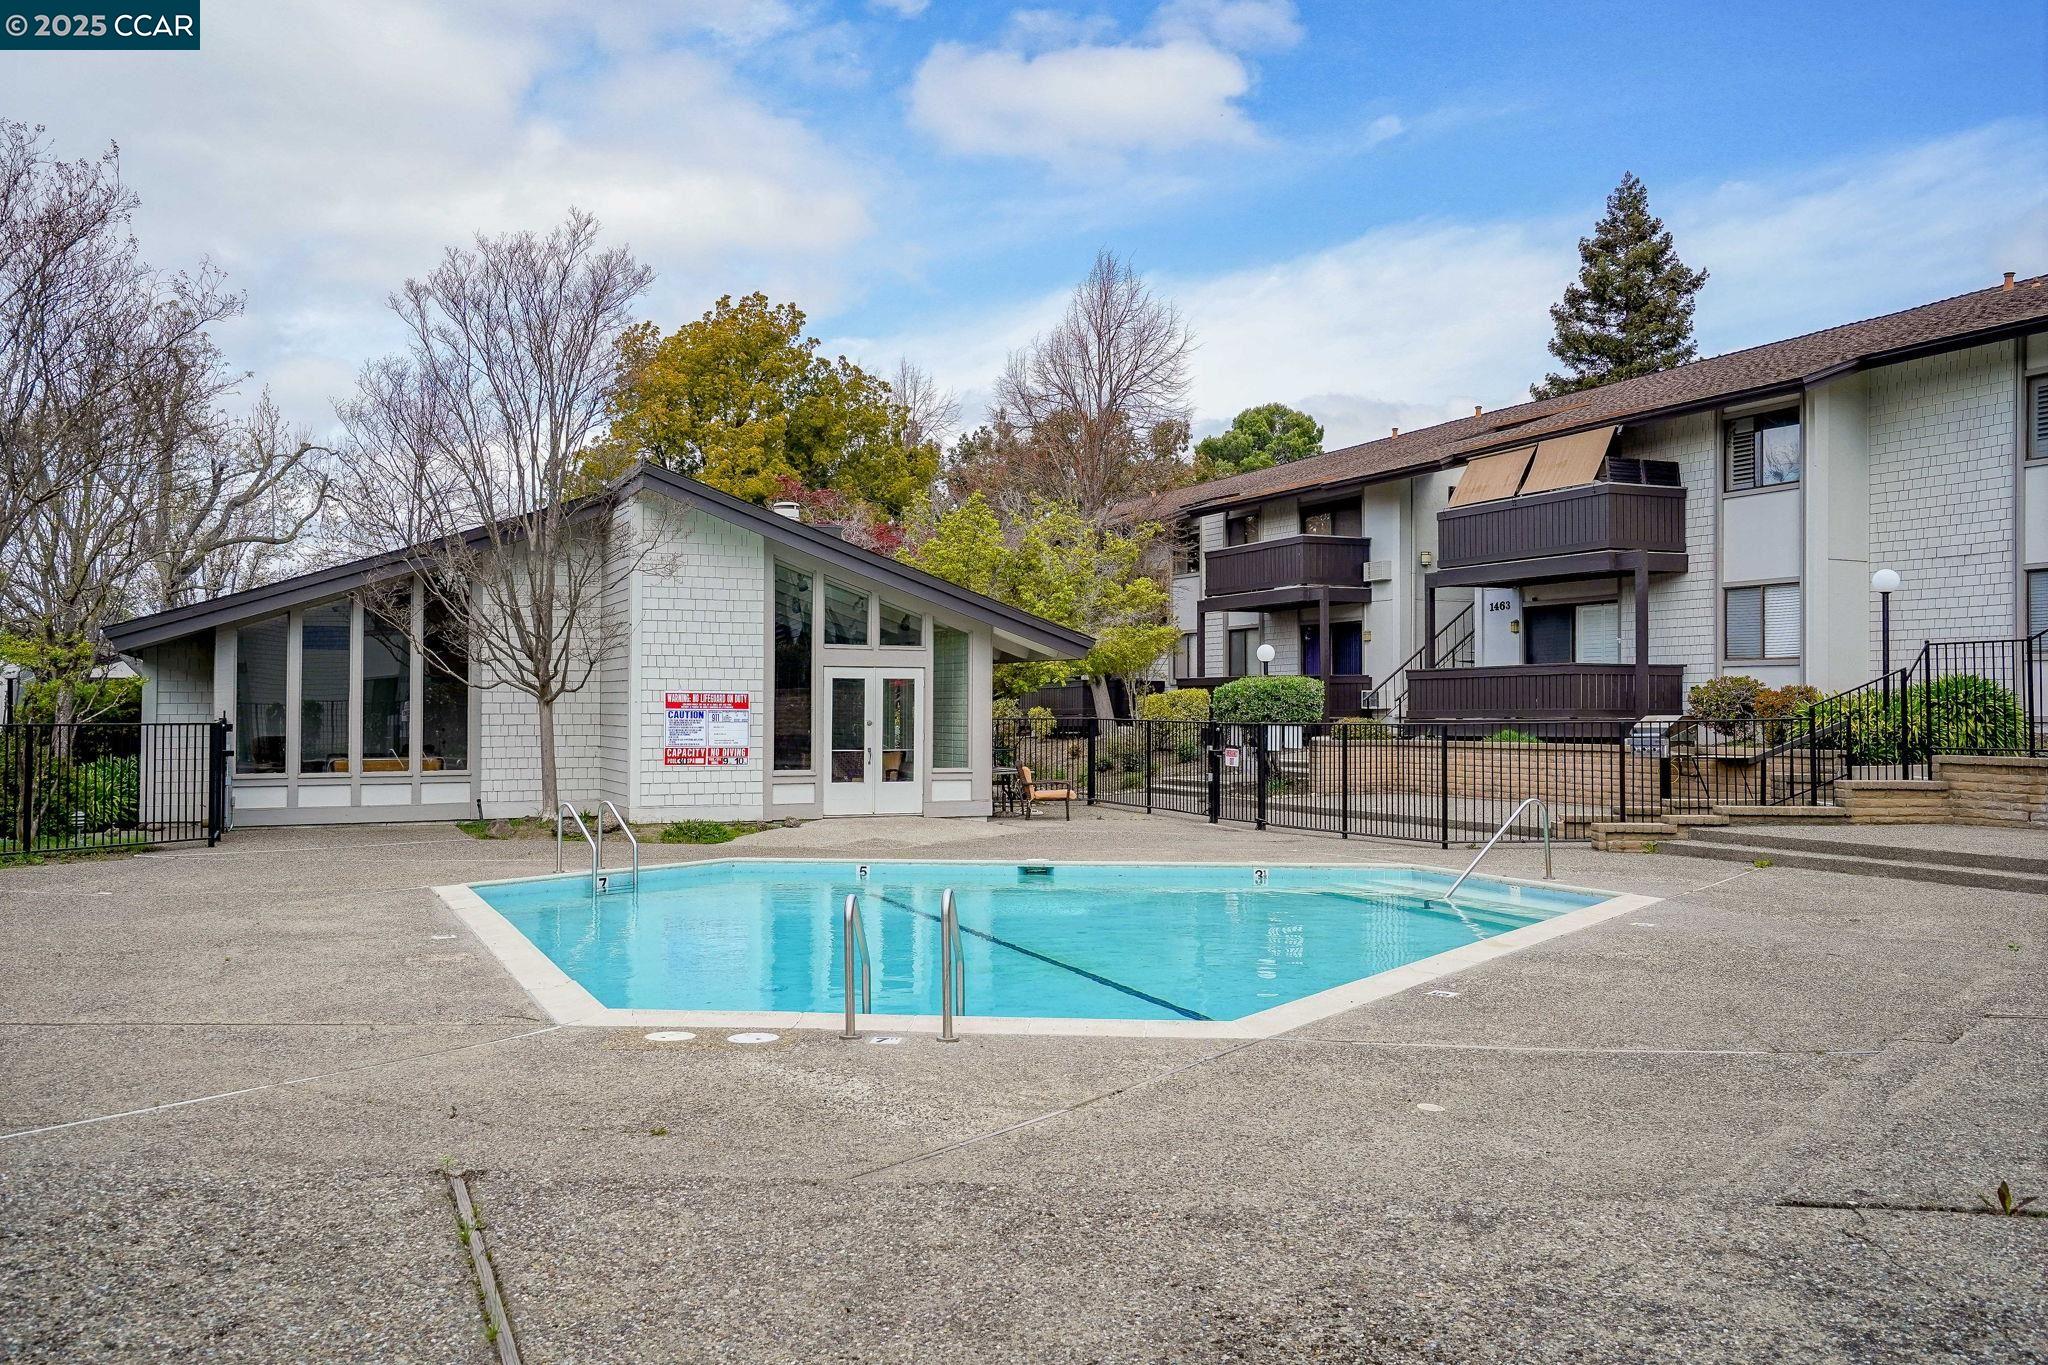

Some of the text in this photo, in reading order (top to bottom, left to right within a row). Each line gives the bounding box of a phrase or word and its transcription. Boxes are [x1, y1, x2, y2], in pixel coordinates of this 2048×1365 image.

[1489, 600, 1511, 611] 1463
[692, 693, 700, 703] NO
[700, 693, 726, 703] LIFEGUARD
[726, 694, 734, 703] ON
[734, 694, 748, 703] DUTY
[668, 710, 705, 719] CAUTION
[712, 713, 720, 722] 911
[667, 748, 706, 757] CAPACITY
[710, 748, 746, 757] NO DIVING
[734, 757, 744, 765] 10
[859, 866, 867, 877] 5
